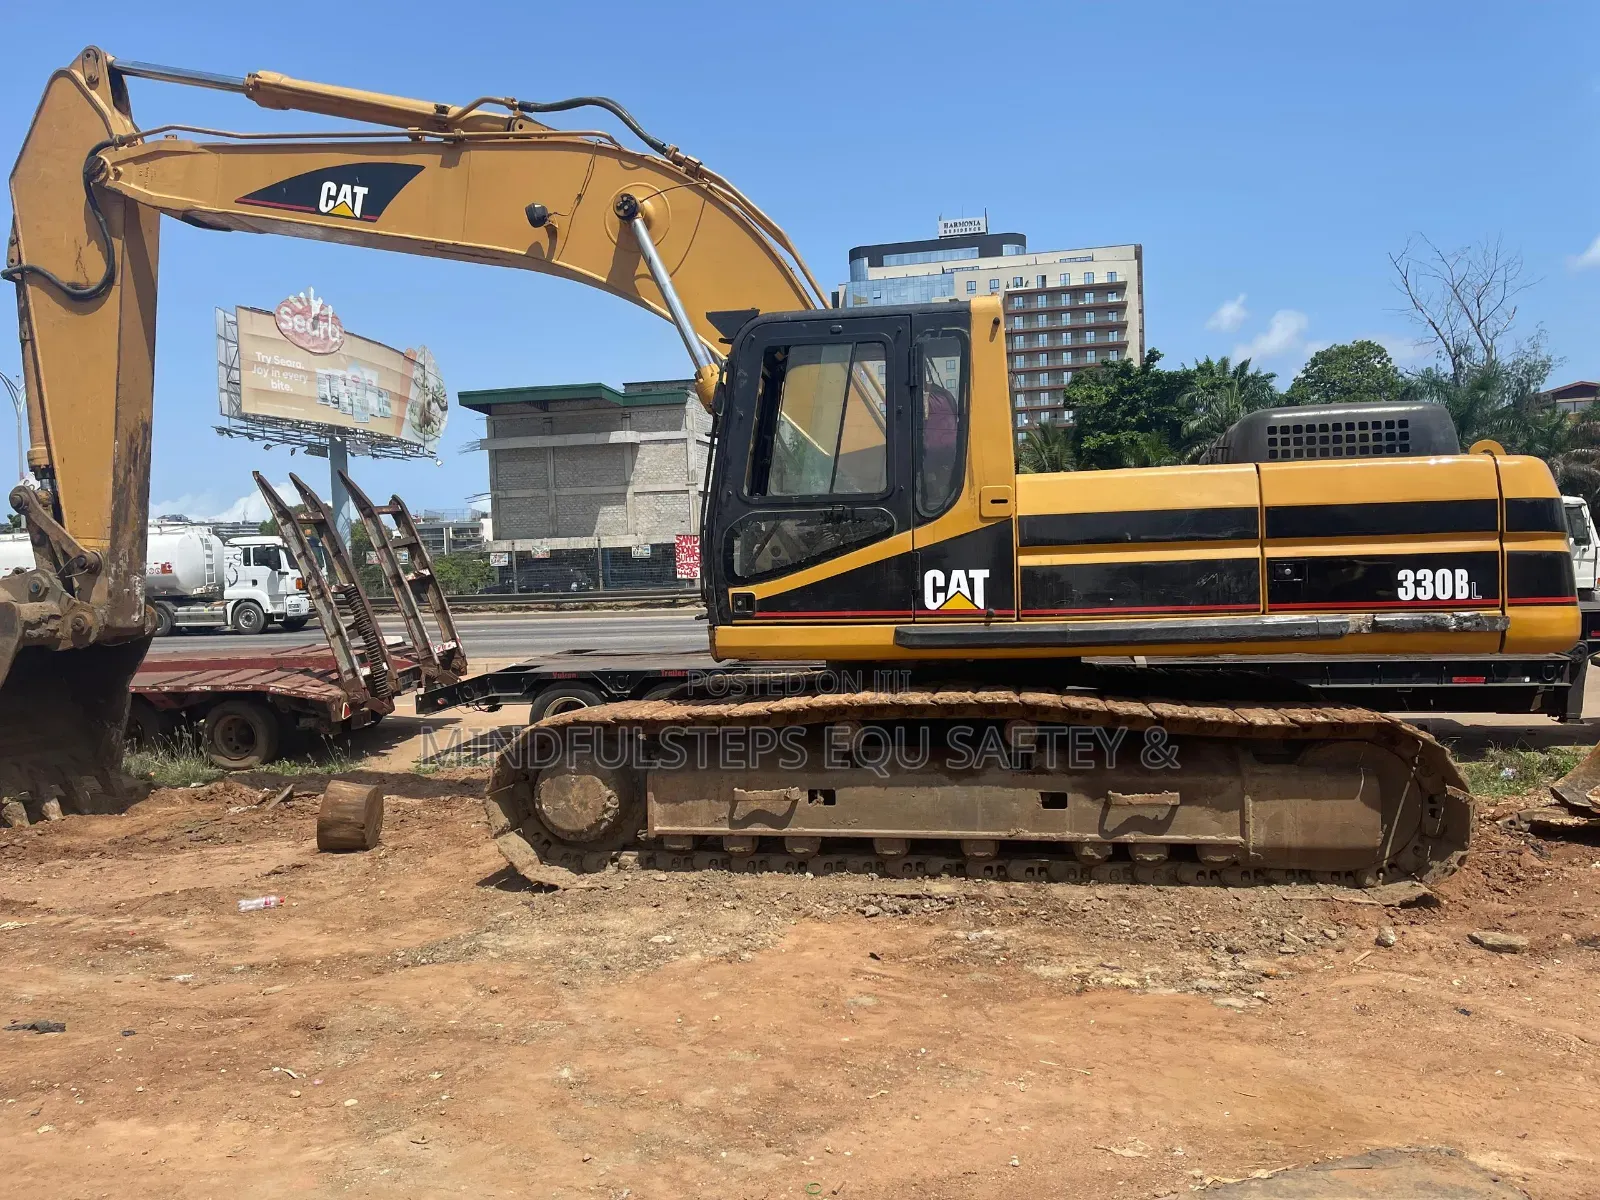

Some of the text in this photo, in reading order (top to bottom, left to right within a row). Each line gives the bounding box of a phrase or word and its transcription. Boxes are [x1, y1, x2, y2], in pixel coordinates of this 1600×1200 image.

[319, 181, 368, 218] CAT
[943, 220, 981, 229] HARMONIA
[255, 352, 305, 370] Try Seara.
[252, 364, 308, 384] Joy in every
[271, 379, 293, 392] bite.
[675, 535, 699, 546] SAND
[924, 569, 990, 610] CAT
